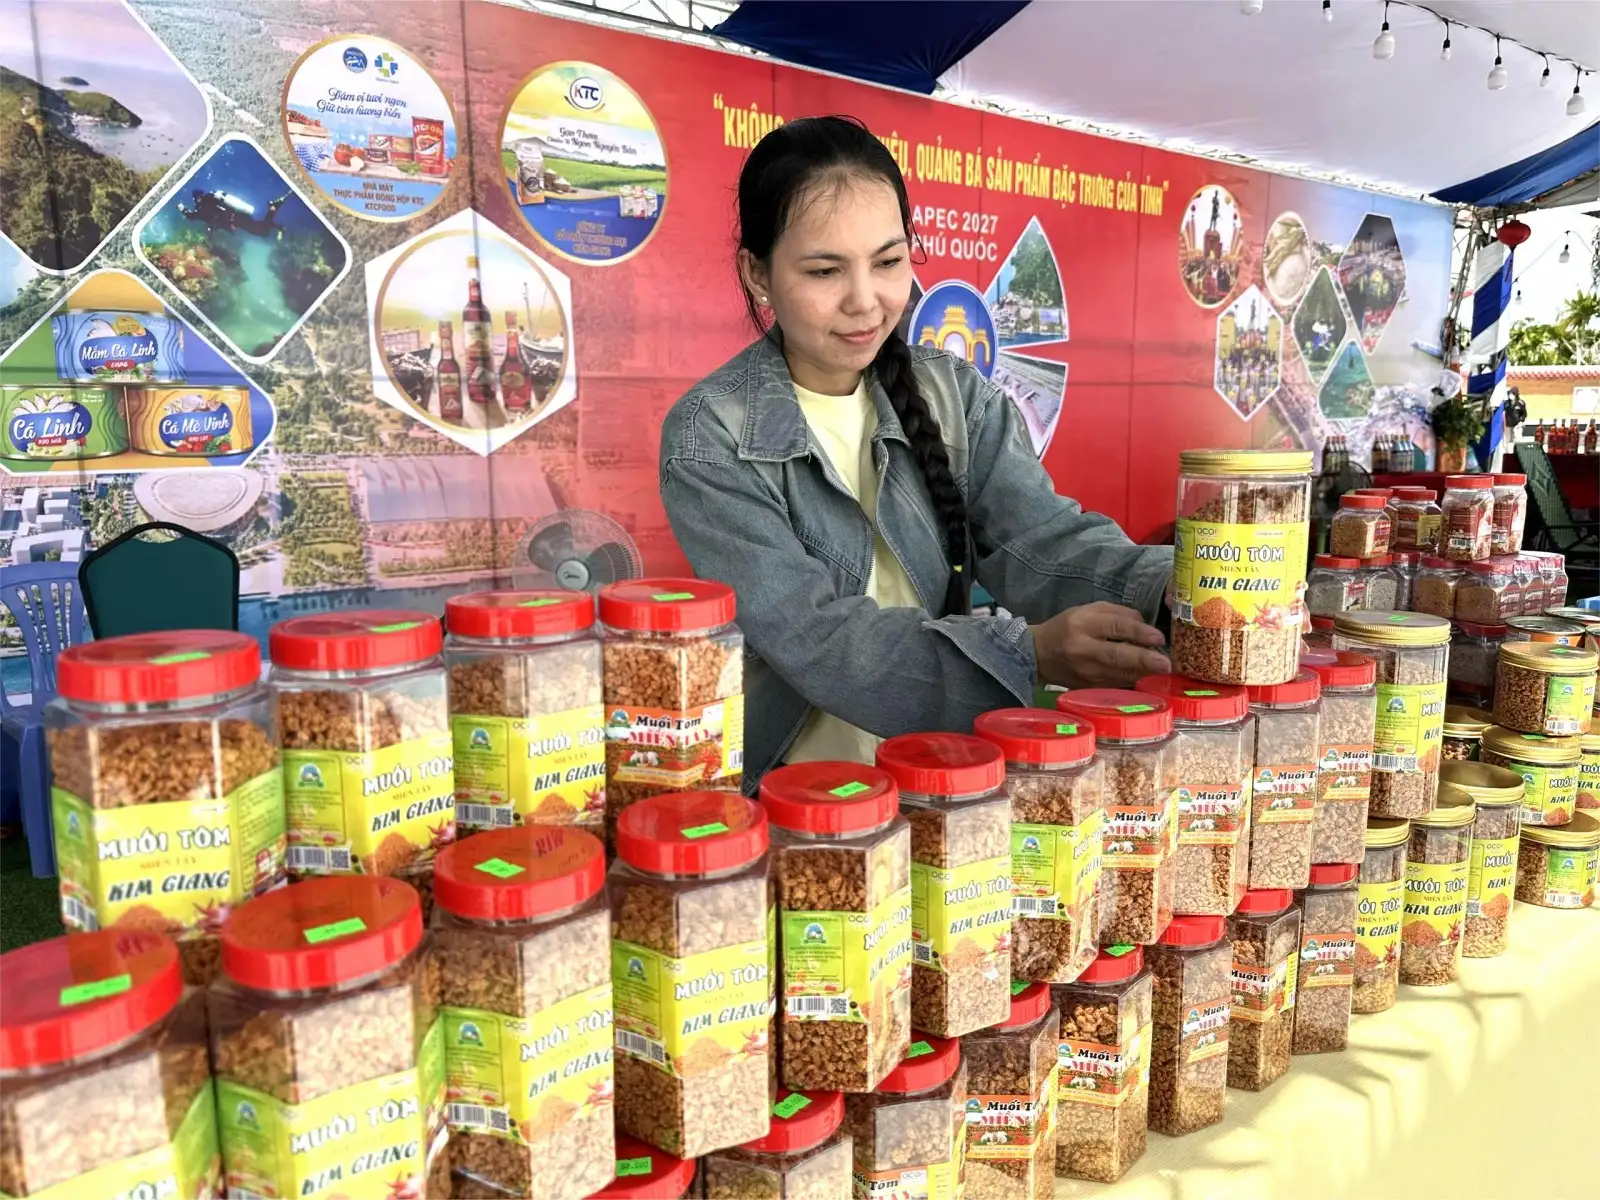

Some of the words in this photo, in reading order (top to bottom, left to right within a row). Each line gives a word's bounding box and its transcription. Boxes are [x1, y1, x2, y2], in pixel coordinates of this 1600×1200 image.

[385, 96, 407, 108] ngon
[574, 85, 599, 101] KTC
[916, 135, 962, 184] QUẢNG
[965, 146, 983, 188] BÁ
[986, 145, 1013, 193] SẢN
[1014, 152, 1051, 199] PHẨM
[1052, 163, 1076, 209] ĐẶC
[1116, 170, 1138, 213] CỦA
[365, 203, 396, 212] KTCFOOD
[412, 197, 425, 205] KTC
[912, 204, 959, 231] APEC
[961, 210, 998, 235] 2027
[911, 231, 947, 256] PHÚ
[82, 345, 109, 360] Mắm
[111, 343, 128, 358] Cá
[130, 340, 157, 357] Linh
[13, 419, 36, 440] Cá
[40, 412, 85, 438] Linh
[162, 420, 179, 435] Cá
[182, 418, 201, 433] Mè
[204, 413, 230, 432] Vinh
[1247, 544, 1285, 562] TÔM
[1198, 575, 1228, 590] KIM
[1232, 578, 1281, 591] GIANG
[534, 771, 561, 791] KIM
[372, 809, 401, 833] KIM
[406, 793, 456, 821] GIANG
[1114, 811, 1147, 822] Muối
[177, 825, 231, 849] TÔM
[108, 878, 153, 902] KIM
[161, 870, 231, 893] GIANG
[1488, 878, 1506, 889] KIM
[1404, 903, 1429, 915] KIM
[950, 918, 973, 935] KIM
[682, 1013, 712, 1036] KIM
[1077, 1047, 1109, 1061] Muối
[529, 1070, 557, 1098] KIM
[366, 1095, 419, 1127] TÔM
[987, 1097, 1021, 1112] Muối
[301, 1165, 342, 1196] KIM
[351, 1140, 418, 1175] GIANG
